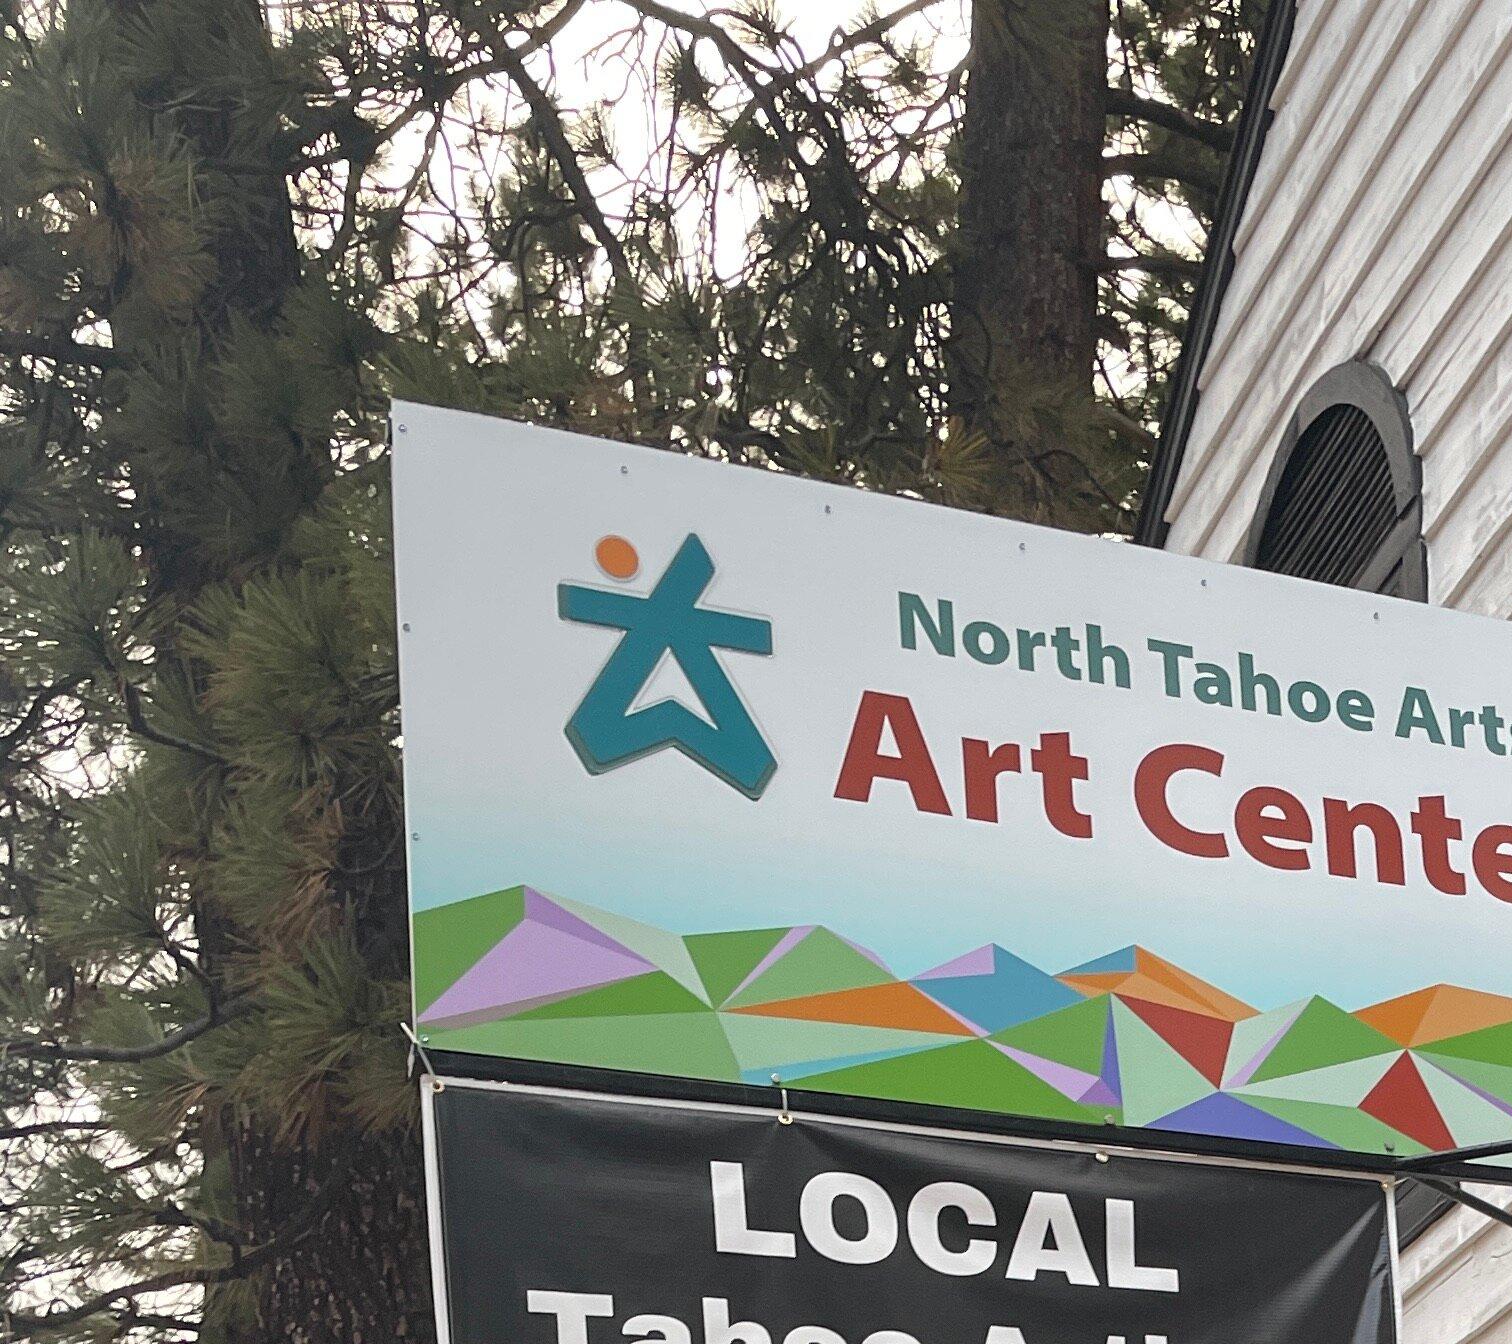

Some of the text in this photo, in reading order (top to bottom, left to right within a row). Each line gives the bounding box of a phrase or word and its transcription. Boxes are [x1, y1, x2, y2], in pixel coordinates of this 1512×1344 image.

[898, 591, 1131, 689] North
[1148, 636, 1375, 732] Tahoe
[833, 691, 1093, 839] Art
[710, 1160, 1180, 1293] LOCAL
